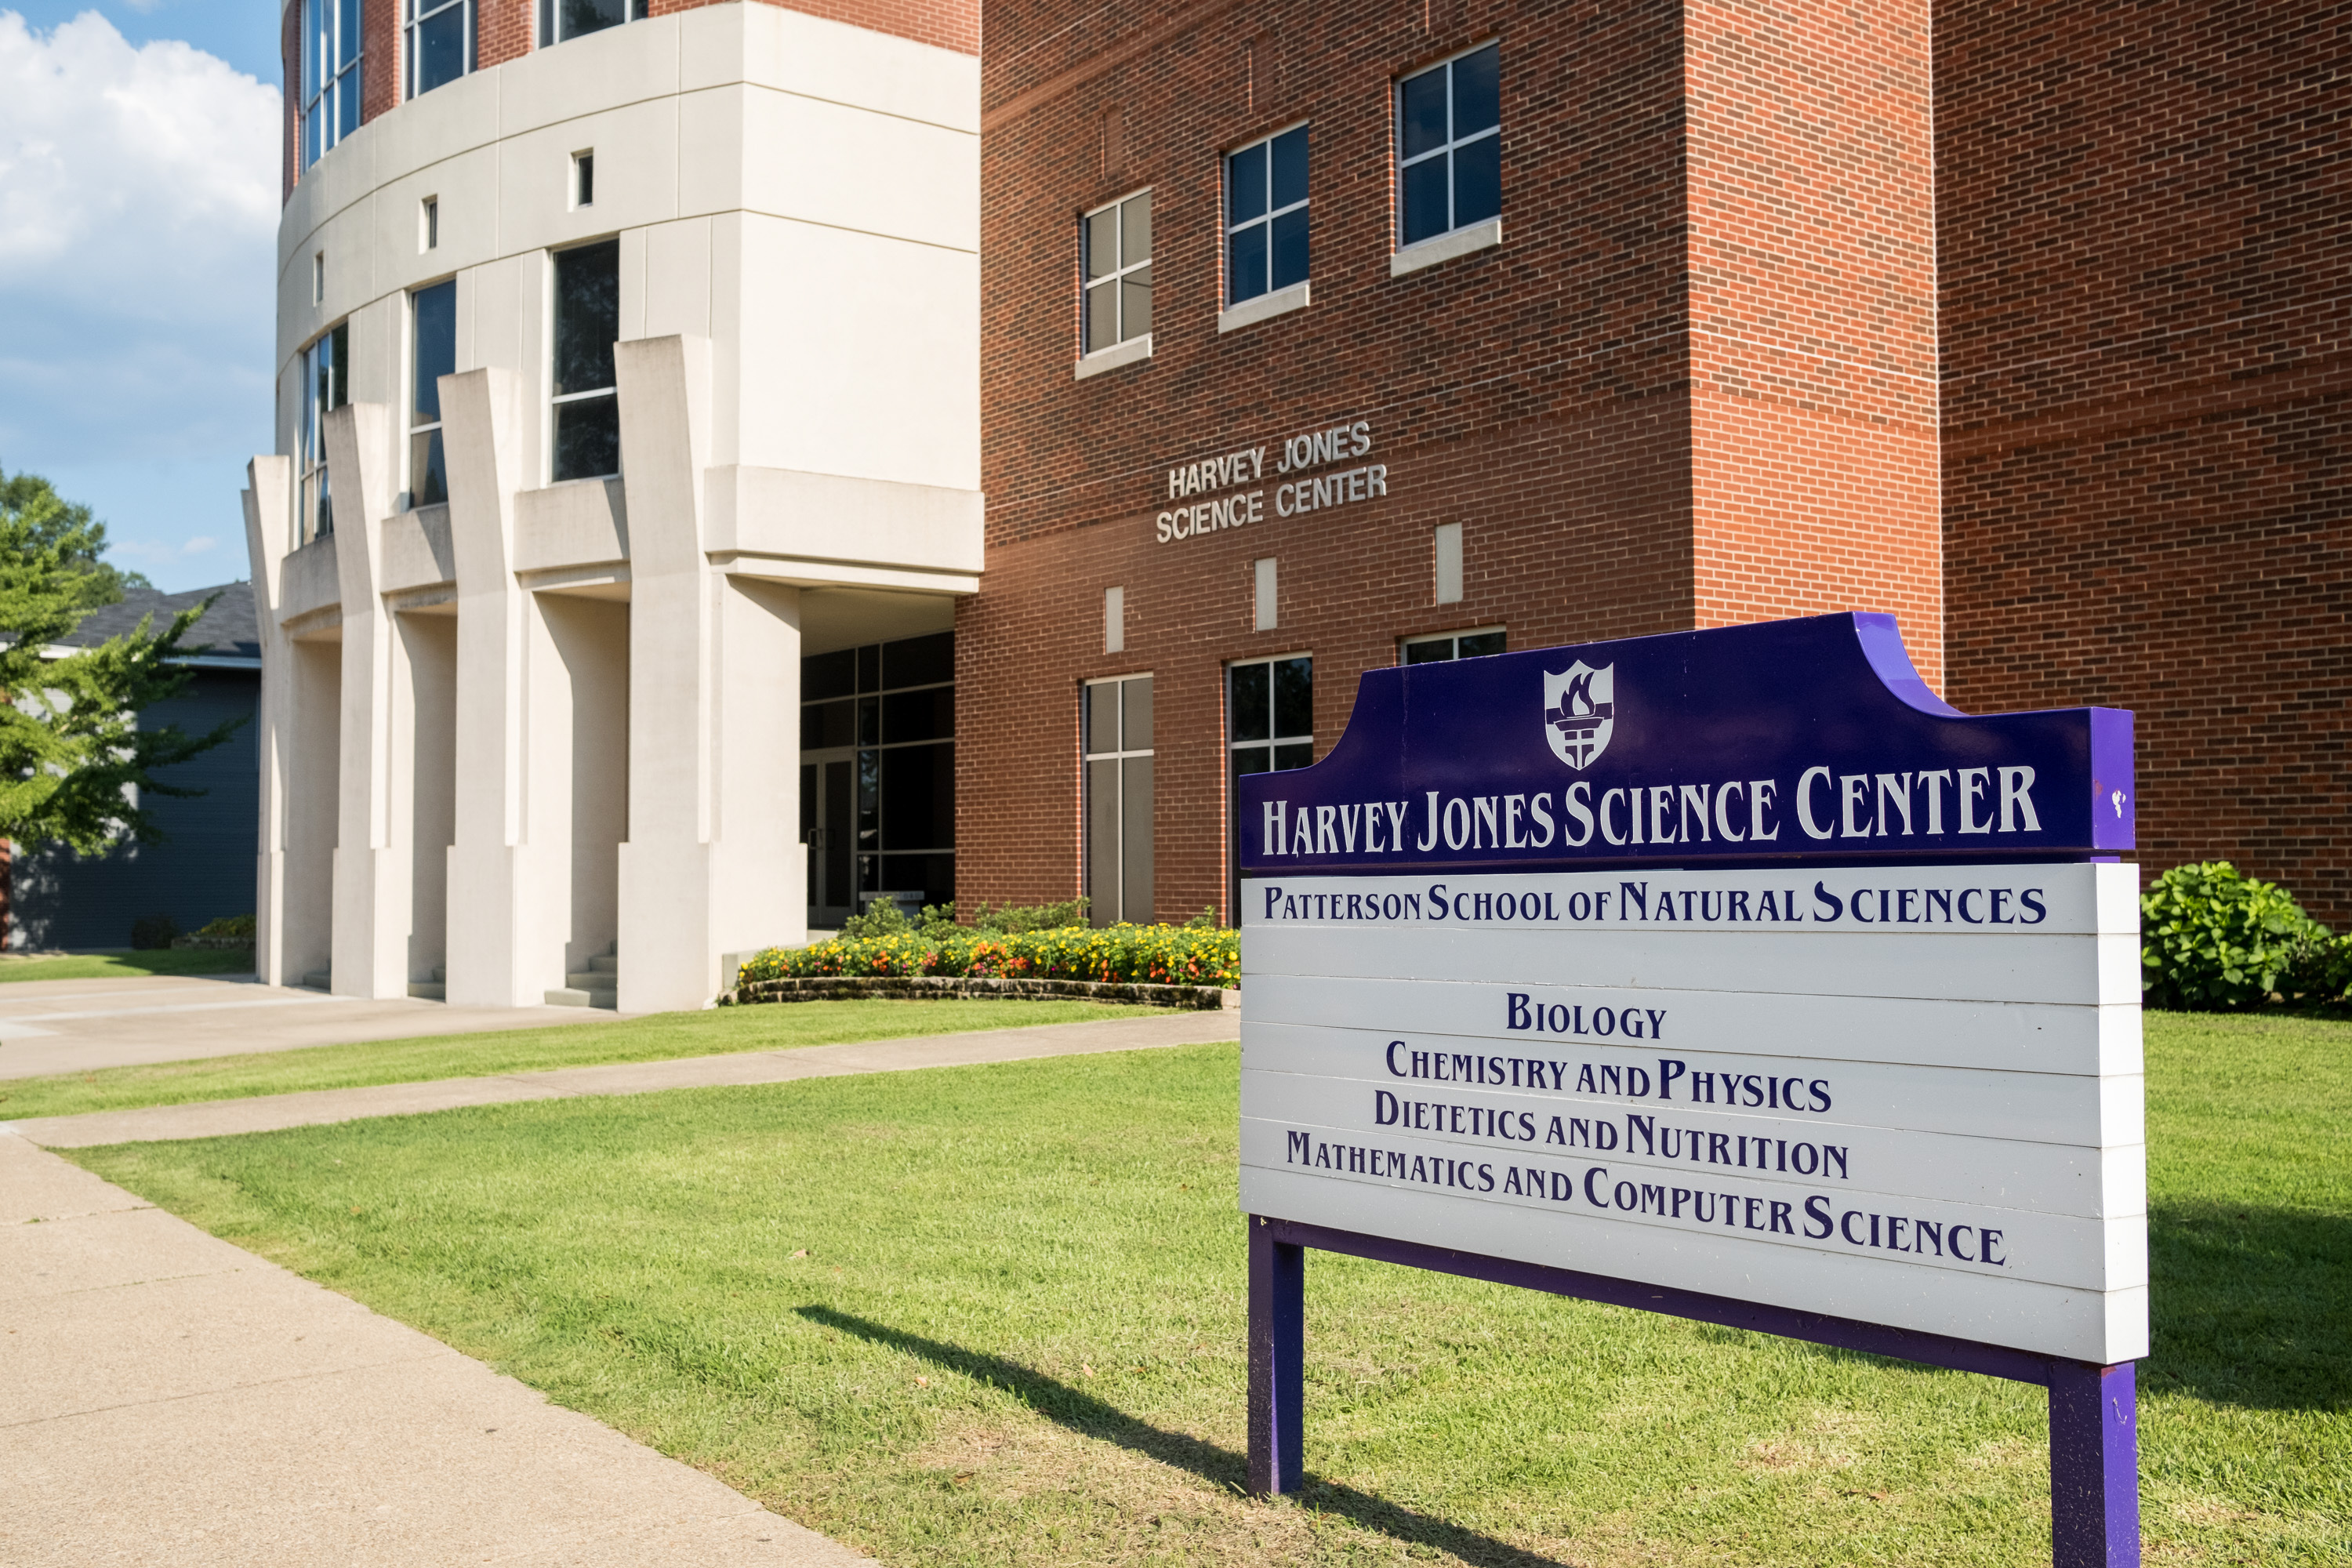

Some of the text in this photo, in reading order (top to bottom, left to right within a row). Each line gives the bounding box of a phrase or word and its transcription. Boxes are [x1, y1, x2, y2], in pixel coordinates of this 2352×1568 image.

[1169, 421, 1370, 499] HARVEY JONES
[1156, 464, 1387, 543] SCIENCE CENTER
[1262, 765, 2042, 858] HARVEY JONES SCIENCE CENTER
[1264, 880, 2047, 924] PATTERSON SCHOOL OF NATURAL SCIENCES
[1506, 993, 1668, 1040] BIOLOGY
[1386, 1040, 1831, 1113] CHEMISTRY AND PHYSICS
[1374, 1090, 1849, 1180] DIETETICS AND NUTRITION
[1287, 1130, 2006, 1267] MATHEMATICS AND COMPUTER SCIENCE
